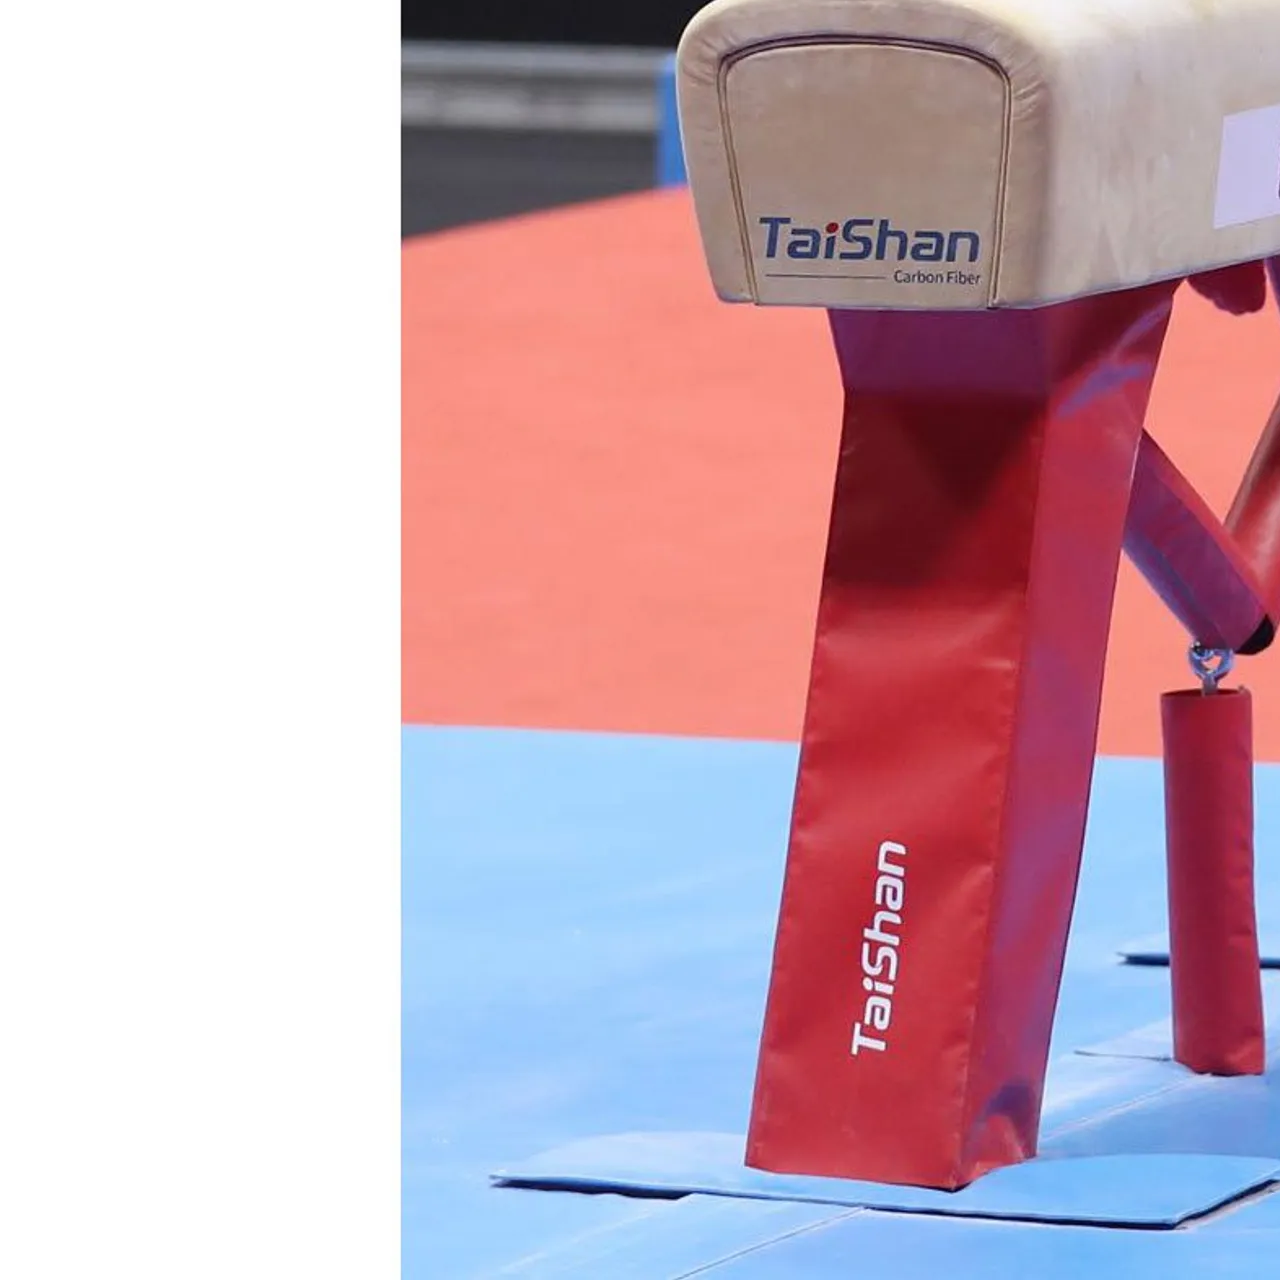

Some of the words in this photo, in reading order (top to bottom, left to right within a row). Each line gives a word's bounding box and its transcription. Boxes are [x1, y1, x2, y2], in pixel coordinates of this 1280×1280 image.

[759, 216, 981, 263] TaiShan
[893, 269, 944, 285] Carbon
[946, 270, 981, 286] Fiber
[850, 839, 908, 1057] TaiShan
